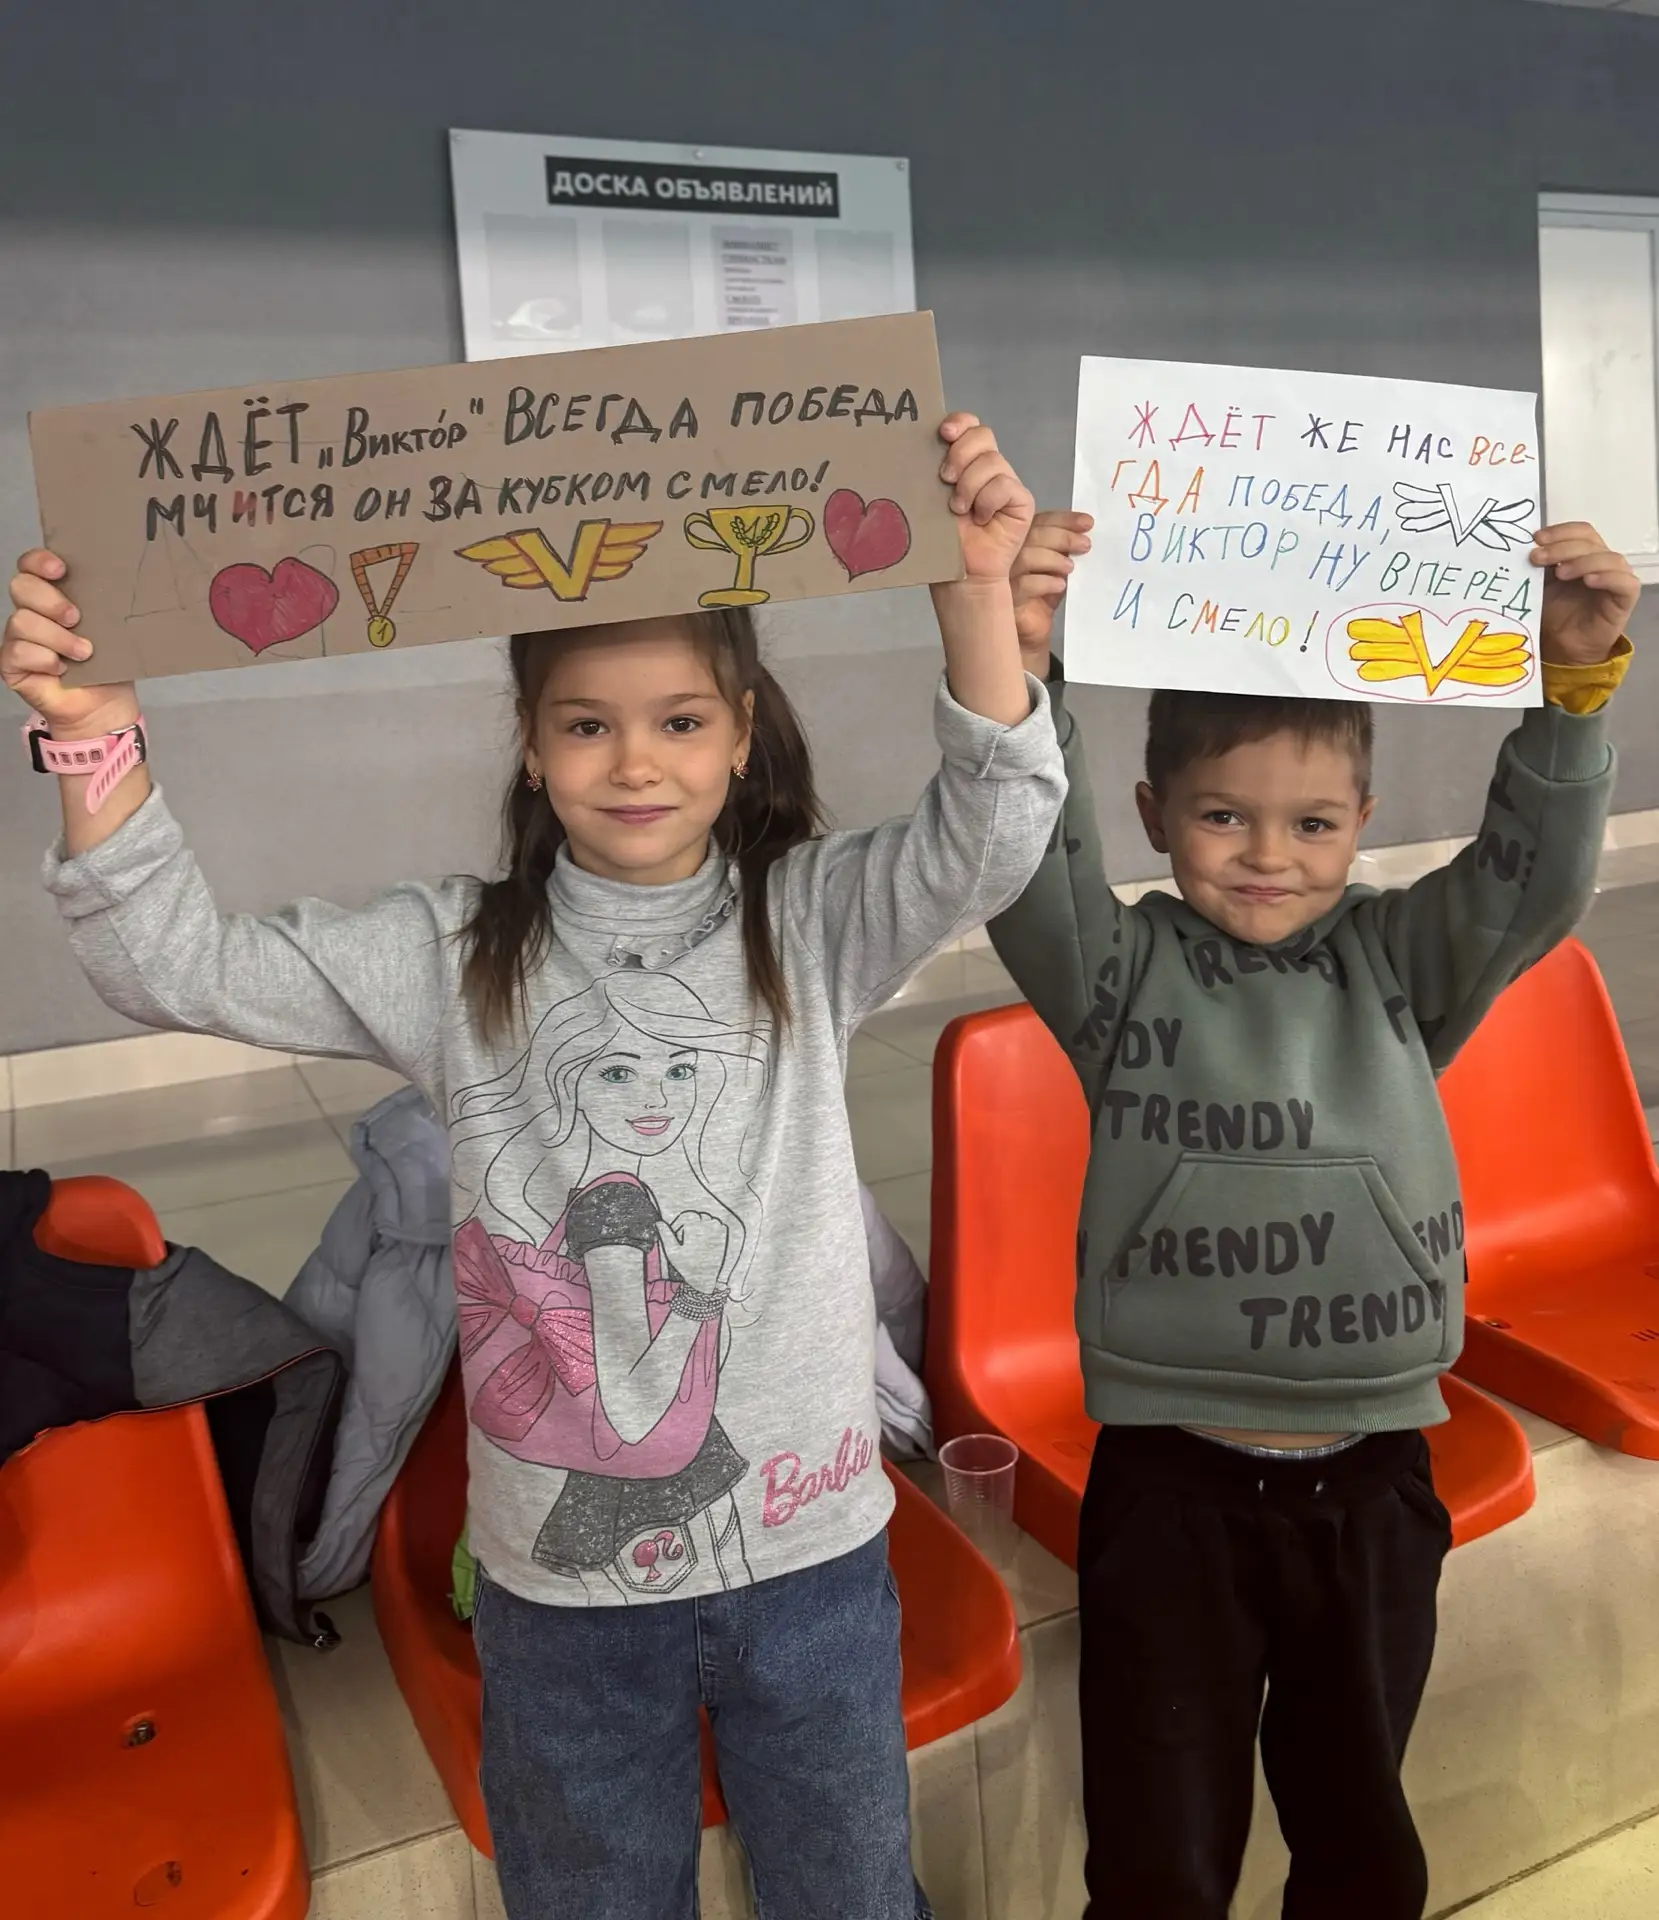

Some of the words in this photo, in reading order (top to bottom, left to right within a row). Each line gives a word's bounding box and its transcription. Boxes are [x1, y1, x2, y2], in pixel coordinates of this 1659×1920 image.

[552, 171, 650, 198] ДОСКА
[655, 176, 835, 206] ОБЪЯВЛЕНИЙ
[130, 396, 310, 484] ЖДЁТ
[505, 386, 699, 446] ВСЕГДА
[730, 384, 919, 428] ПОБЕДА
[1127, 400, 1277, 451] ЖДЁТ
[1300, 412, 1365, 451] ЖЕ
[1386, 424, 1455, 460] НАС
[497, 471, 652, 516] КУБКОМ
[1110, 460, 1205, 516] ГДА
[1130, 512, 1300, 571] ВИКТОР
[1308, 540, 1371, 593] НУ
[1380, 551, 1533, 622] ВПЕРЁД
[1112, 578, 1146, 629] И
[1105, 1089, 1315, 1152] TRENDY
[1116, 1211, 1335, 1279] TRENDY
[759, 1426, 874, 1528] Barbie
